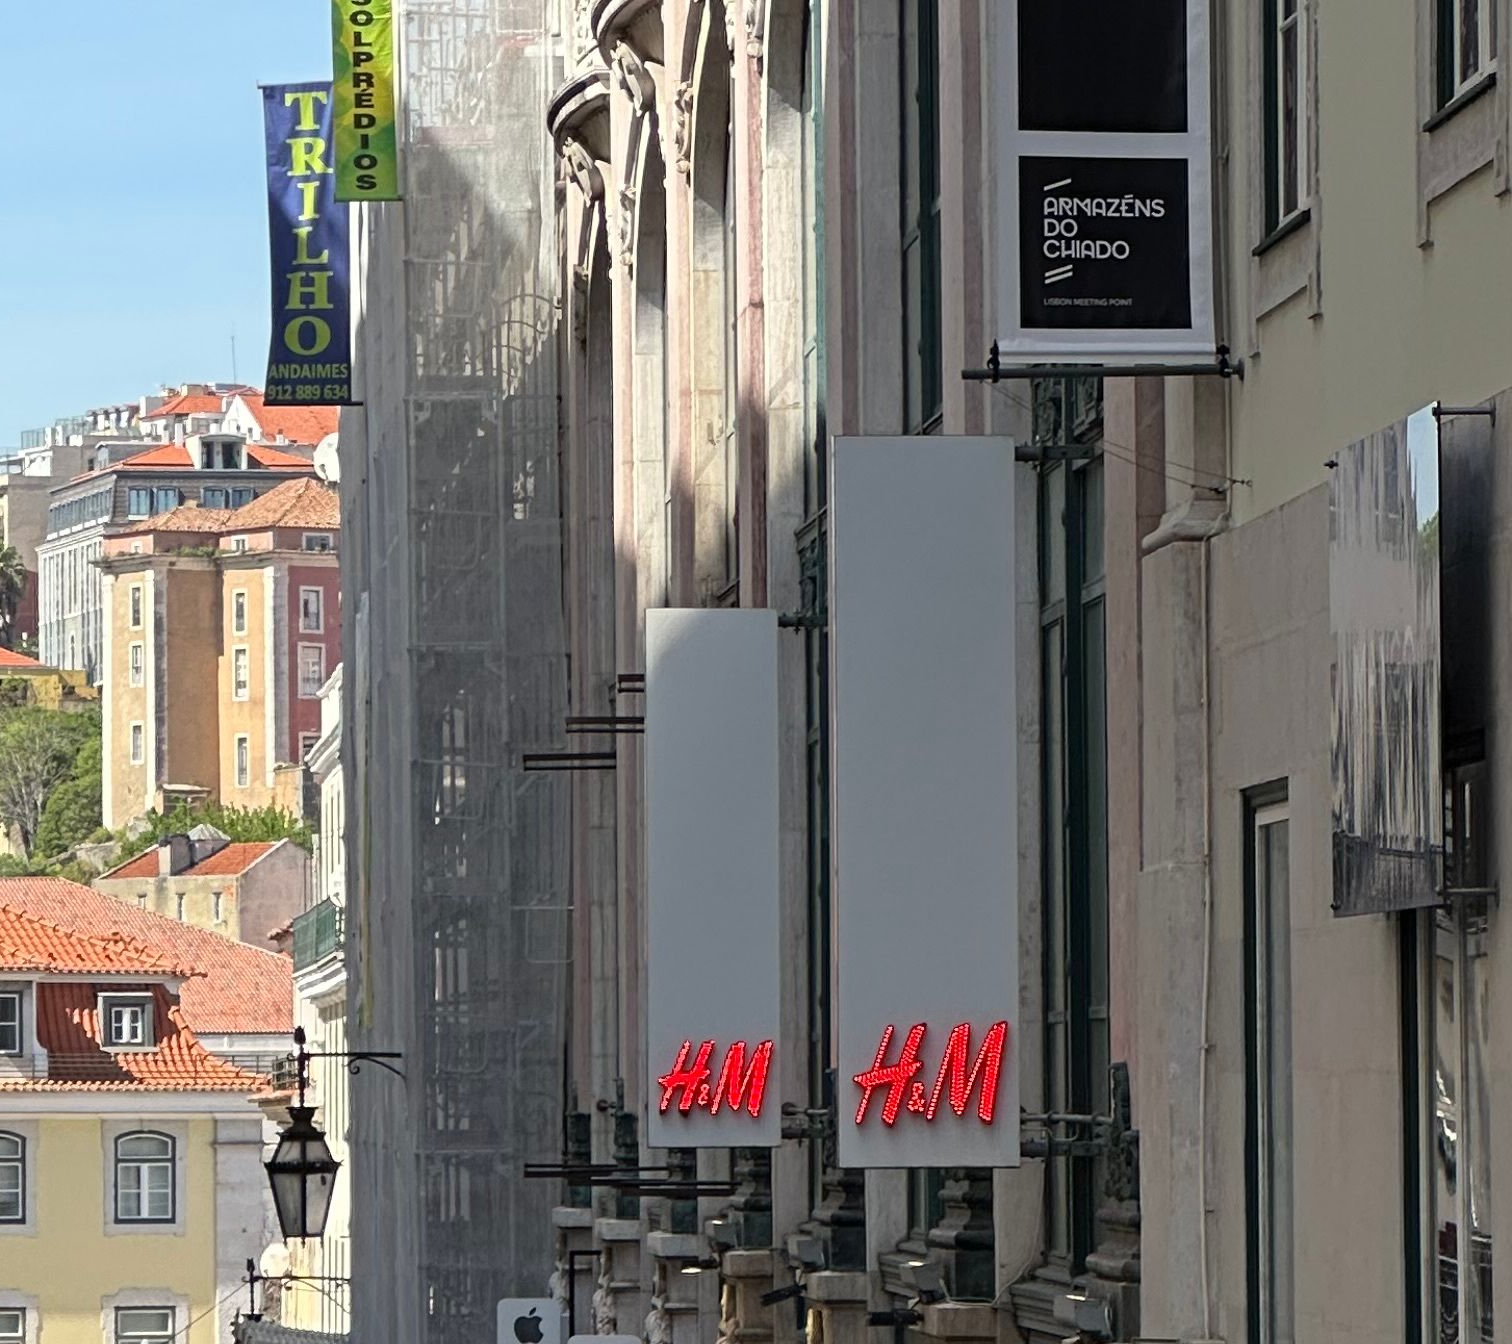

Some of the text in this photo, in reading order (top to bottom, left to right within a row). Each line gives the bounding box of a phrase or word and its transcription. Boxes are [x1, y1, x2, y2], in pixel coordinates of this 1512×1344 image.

[1043, 194, 1165, 218] ARMAZÉNS
[284, 91, 334, 356] TRILHO
[1044, 218, 1078, 237] DO
[1043, 239, 1130, 260] CHIADO
[1109, 298, 1133, 306] POINT
[269, 363, 348, 378] ANDAIMES
[268, 385, 348, 400] 912 889 634
[658, 1039, 774, 1118] H&M
[853, 1021, 1008, 1127] H&M
